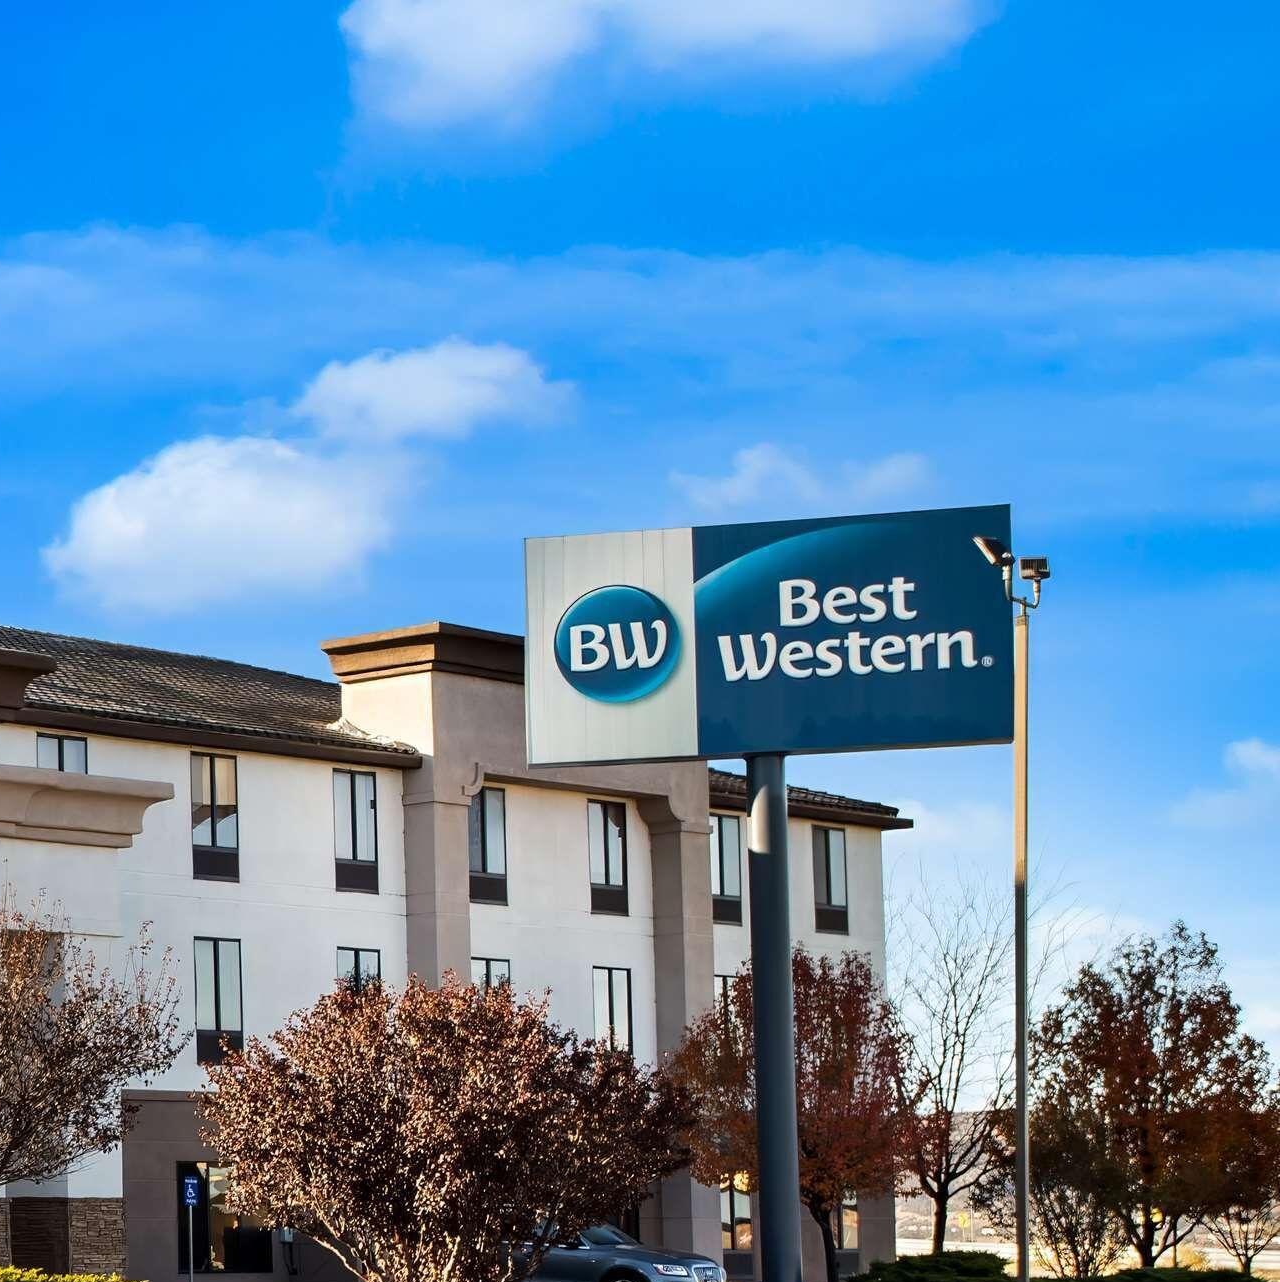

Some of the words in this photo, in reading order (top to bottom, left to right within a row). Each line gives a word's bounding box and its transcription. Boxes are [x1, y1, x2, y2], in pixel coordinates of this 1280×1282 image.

[779, 576, 917, 627] Best
[569, 620, 667, 672] BW
[717, 630, 978, 682] Western
